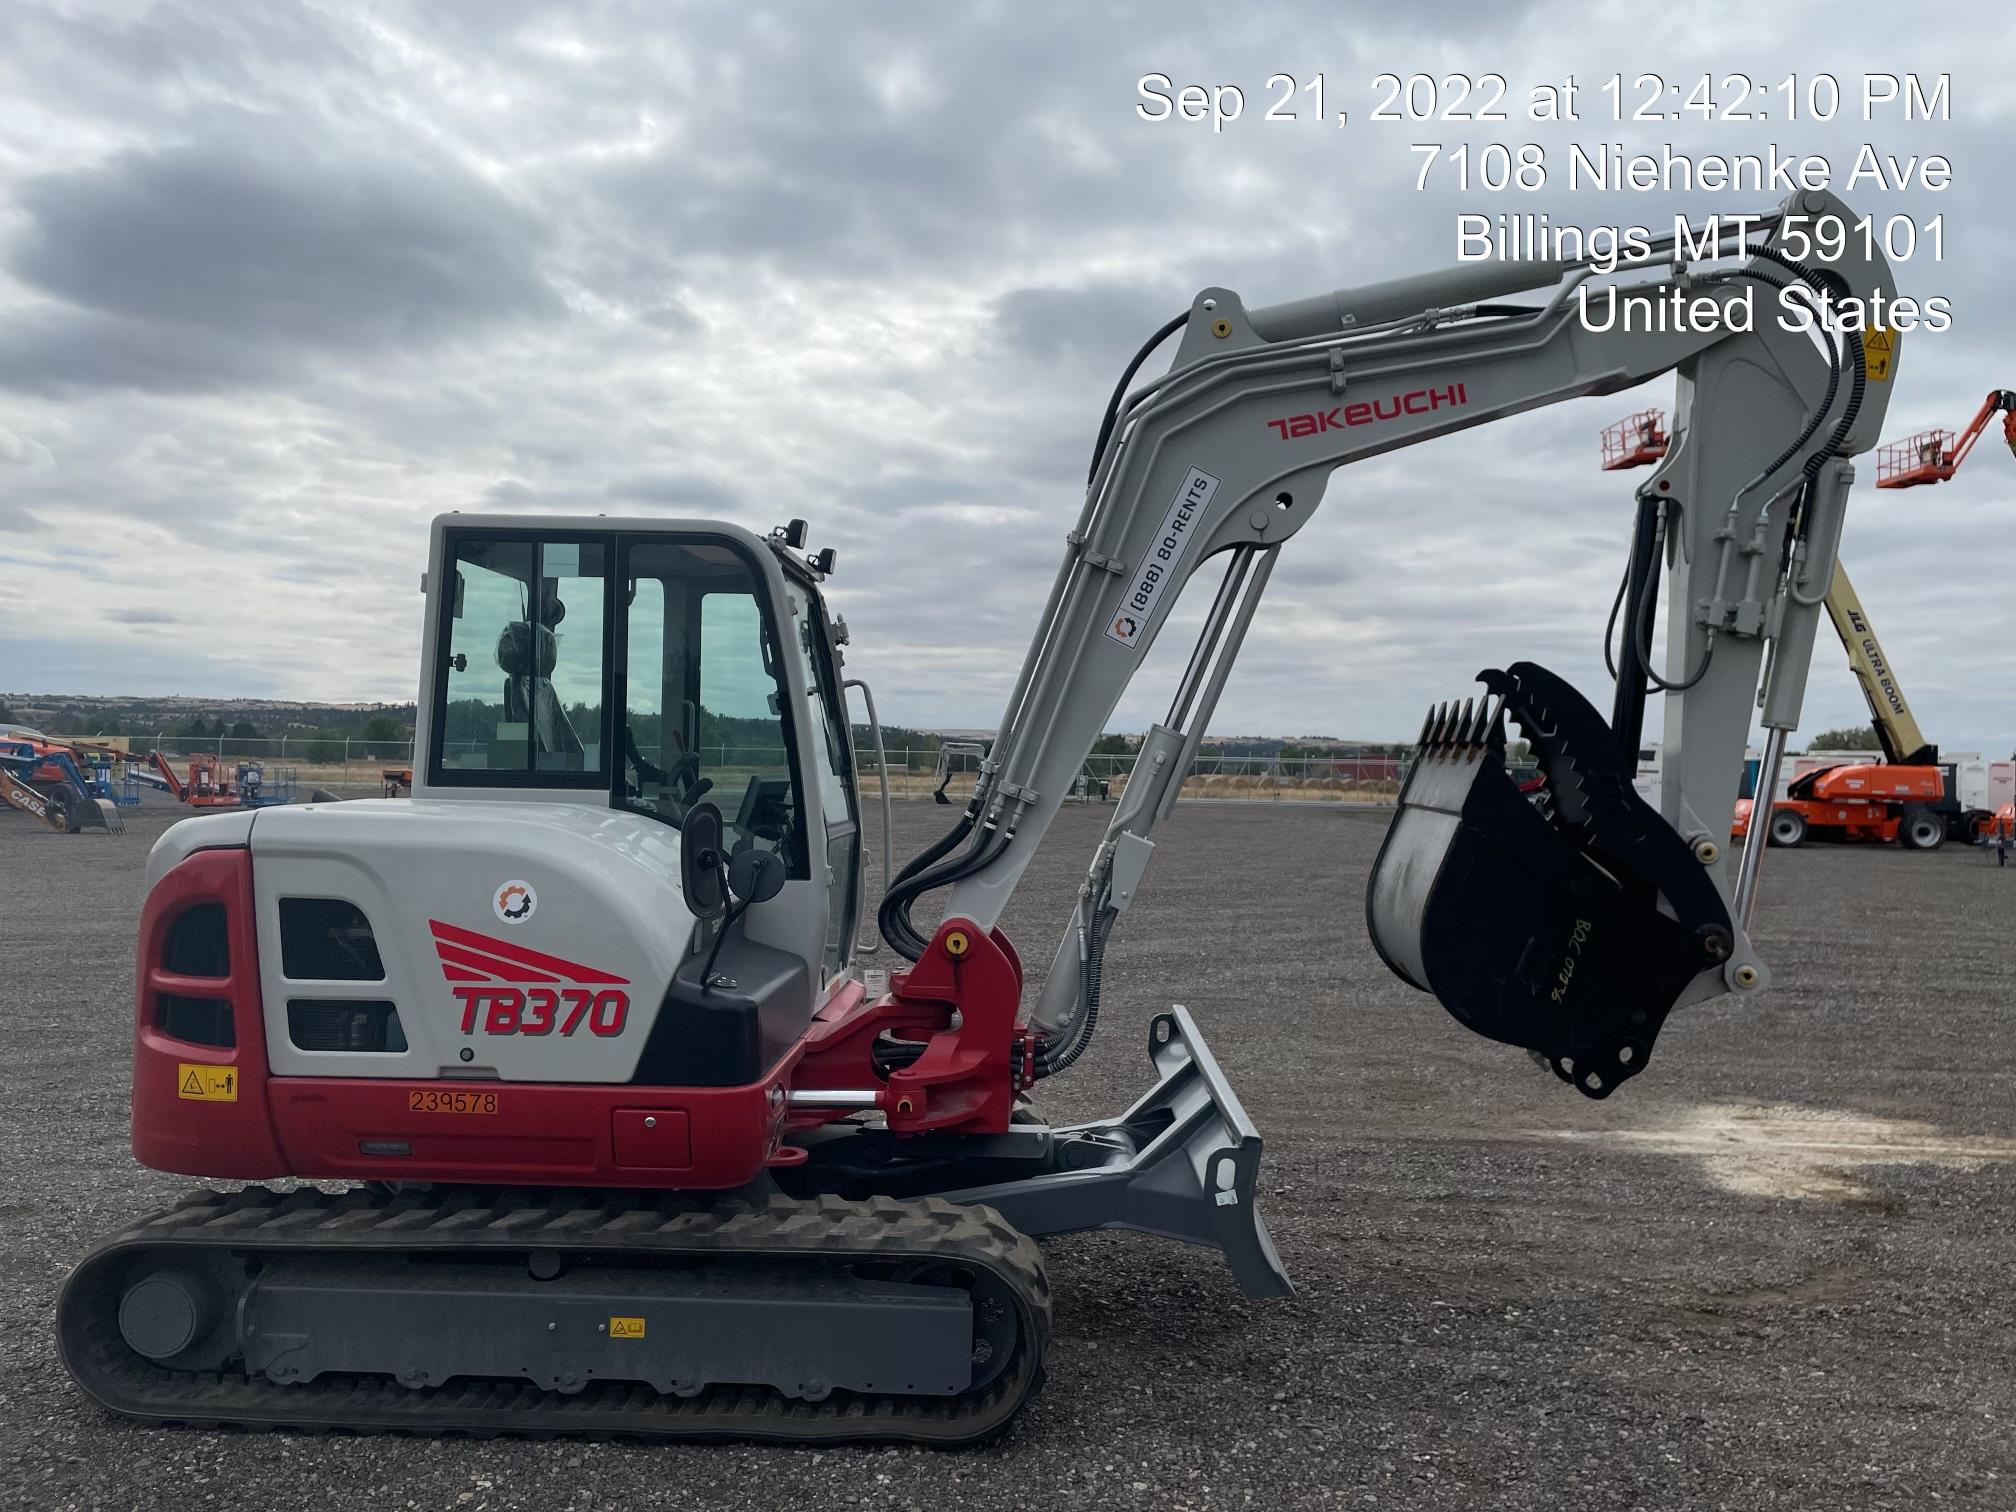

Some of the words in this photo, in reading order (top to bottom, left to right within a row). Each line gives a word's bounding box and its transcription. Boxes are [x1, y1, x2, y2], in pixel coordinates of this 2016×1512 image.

[1130, 564, 1164, 612] (888)
[1157, 478, 1208, 561] 80-RENTS
[1847, 609, 1867, 633] JLG
[1862, 639, 1886, 677] ULTRA
[1880, 678, 1905, 715] BOOM
[10, 790, 46, 817] CASE
[452, 987, 631, 1037] TB370
[411, 1092, 497, 1112] 239578
